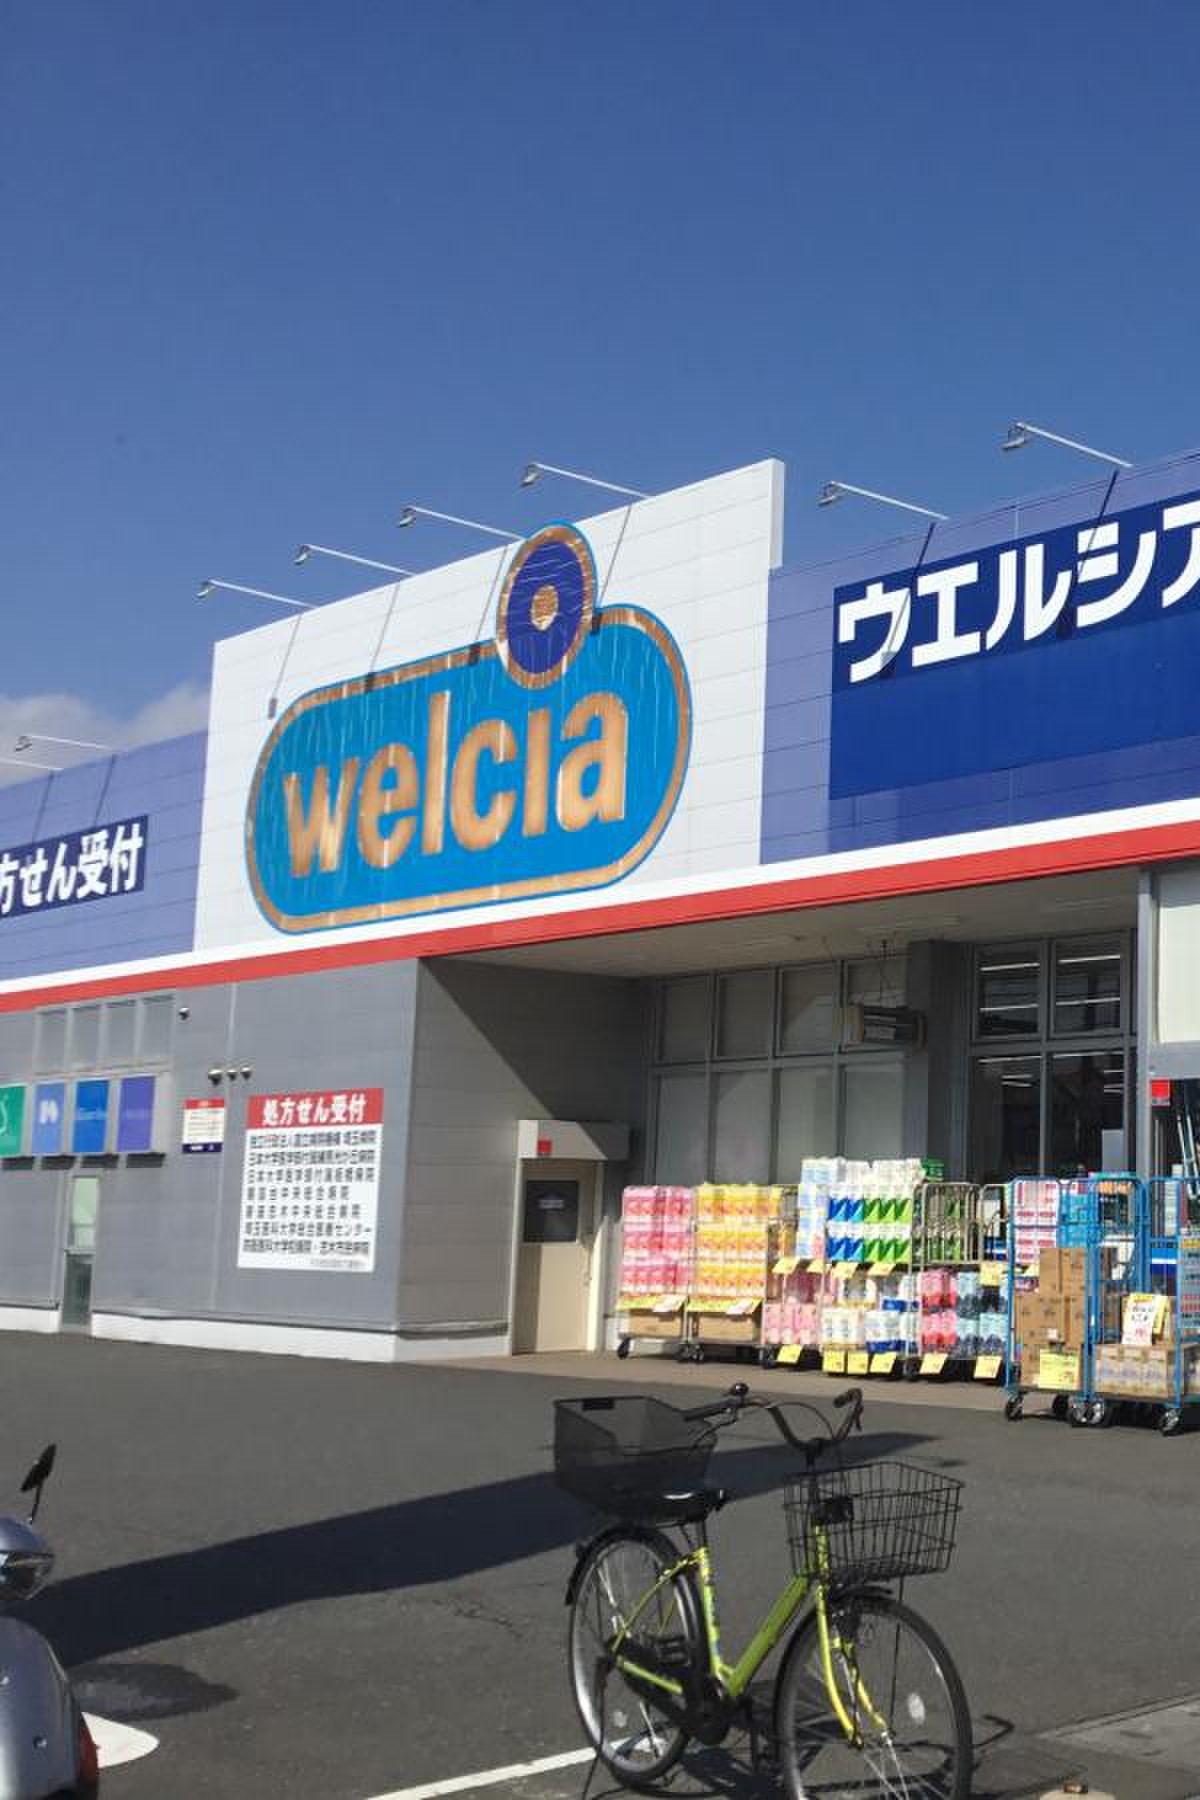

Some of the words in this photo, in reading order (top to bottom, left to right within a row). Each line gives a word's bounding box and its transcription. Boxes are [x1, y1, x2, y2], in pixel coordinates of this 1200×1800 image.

[282, 690, 630, 879] welcia
[262, 1093, 366, 1126] 処方せん受付
